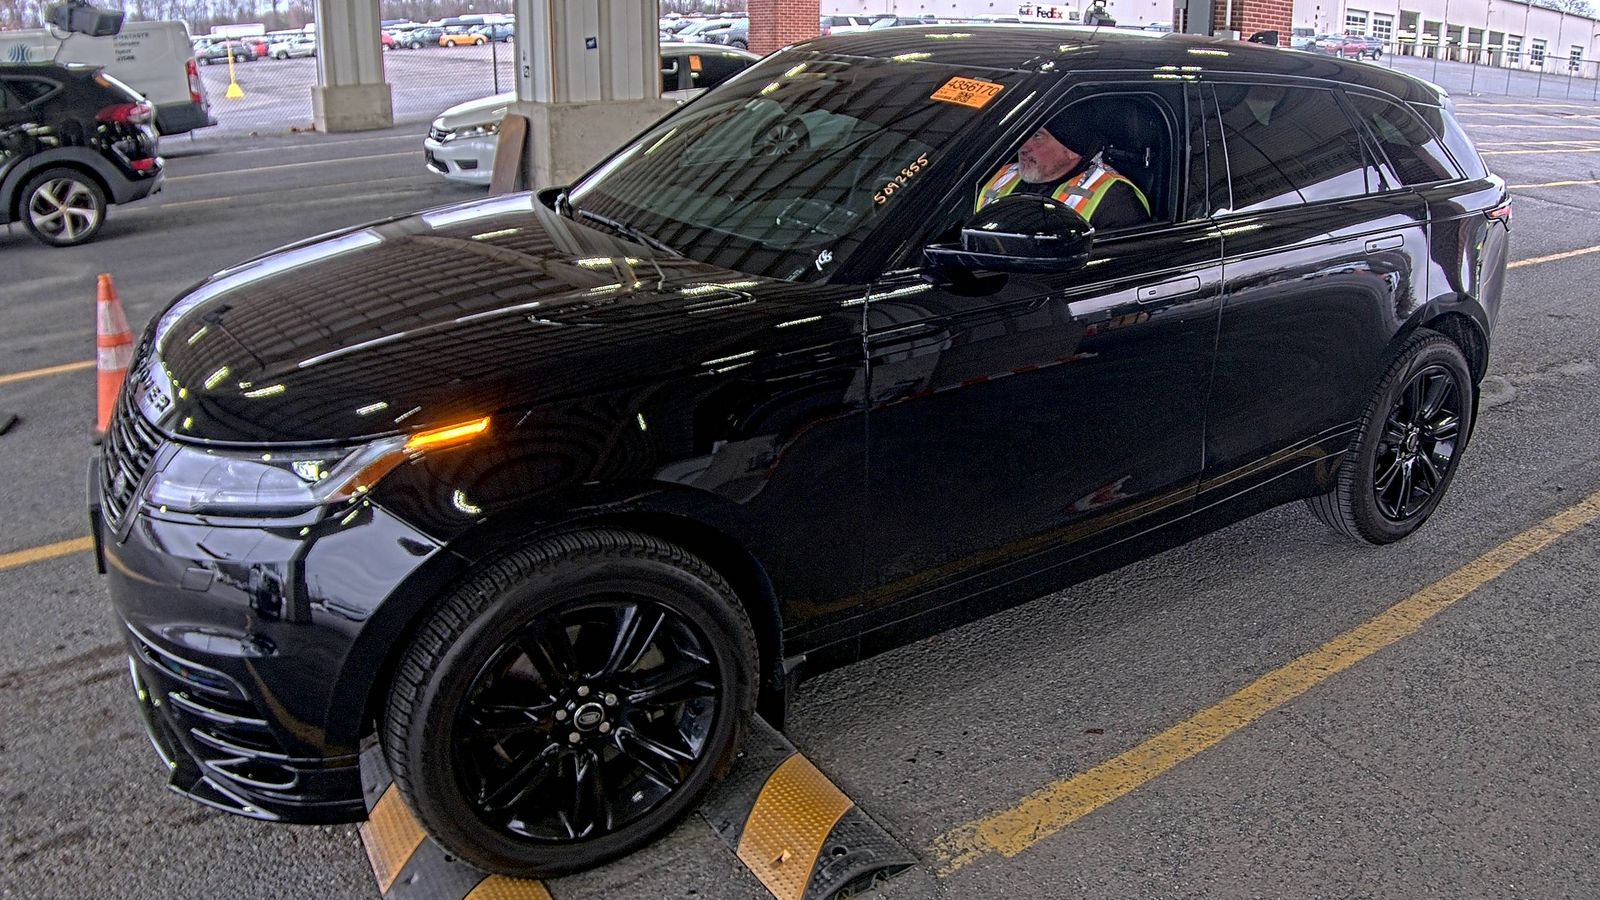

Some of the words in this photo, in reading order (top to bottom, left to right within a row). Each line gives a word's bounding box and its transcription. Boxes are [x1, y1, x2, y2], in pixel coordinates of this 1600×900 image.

[1036, 6, 1063, 19] FedEx
[947, 79, 1000, 96] 4356170
[873, 152, 929, 205] 5092855
